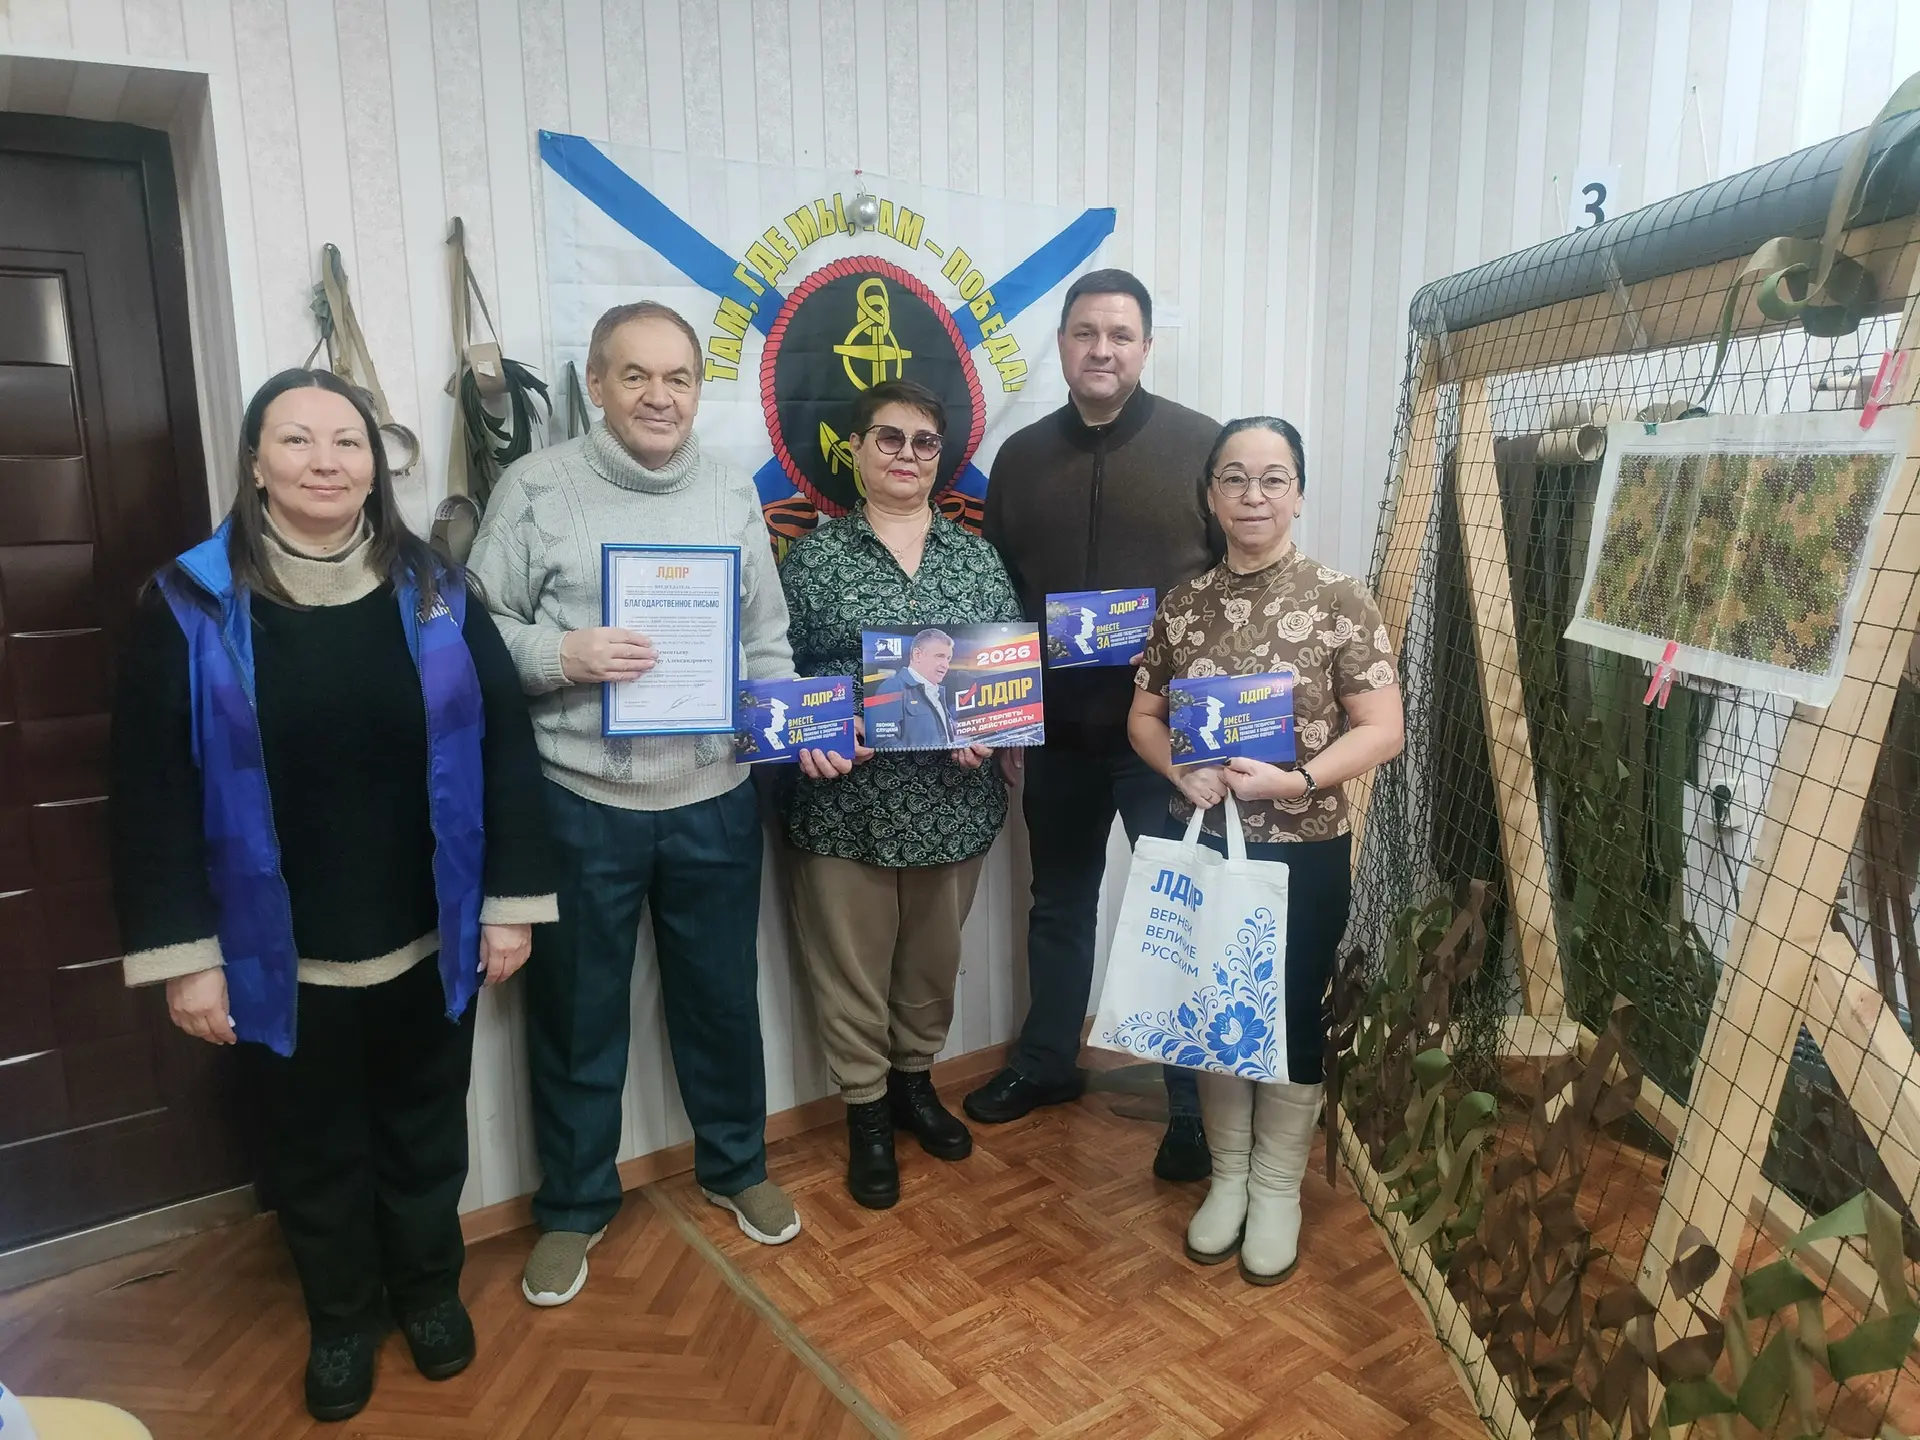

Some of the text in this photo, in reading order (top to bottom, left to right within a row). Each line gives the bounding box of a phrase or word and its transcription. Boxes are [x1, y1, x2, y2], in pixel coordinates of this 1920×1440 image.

[1575, 182, 1607, 233] 3
[704, 296, 759, 382] ТАМ,
[732, 226, 798, 297] ГДЕ
[941, 246, 1028, 392] ПОБЕДА!
[656, 566, 689, 580] ЛДПР
[624, 599, 719, 608] БЛАГОДАРСТВЕННОЕ ПИСЬМО
[1108, 600, 1138, 615] ЛДПР
[1096, 622, 1120, 633] ВМЕСТЕ
[1096, 636, 1111, 650] ЗА
[976, 645, 1031, 666] 2026
[801, 691, 833, 707] ЛДПР
[837, 688, 846, 697] 23
[977, 677, 1033, 707] ЛДПР
[1238, 687, 1272, 704] ЛДПР
[787, 715, 814, 727] ВМЕСТЕ
[956, 717, 986, 728] ХВАТИТ
[956, 714, 1034, 735] ПОРА ДЕЙСТВОВАТЬ!
[1223, 713, 1250, 726] ВМЕСТЕ
[788, 729, 804, 744] ЗА
[1223, 727, 1239, 745] ЗА
